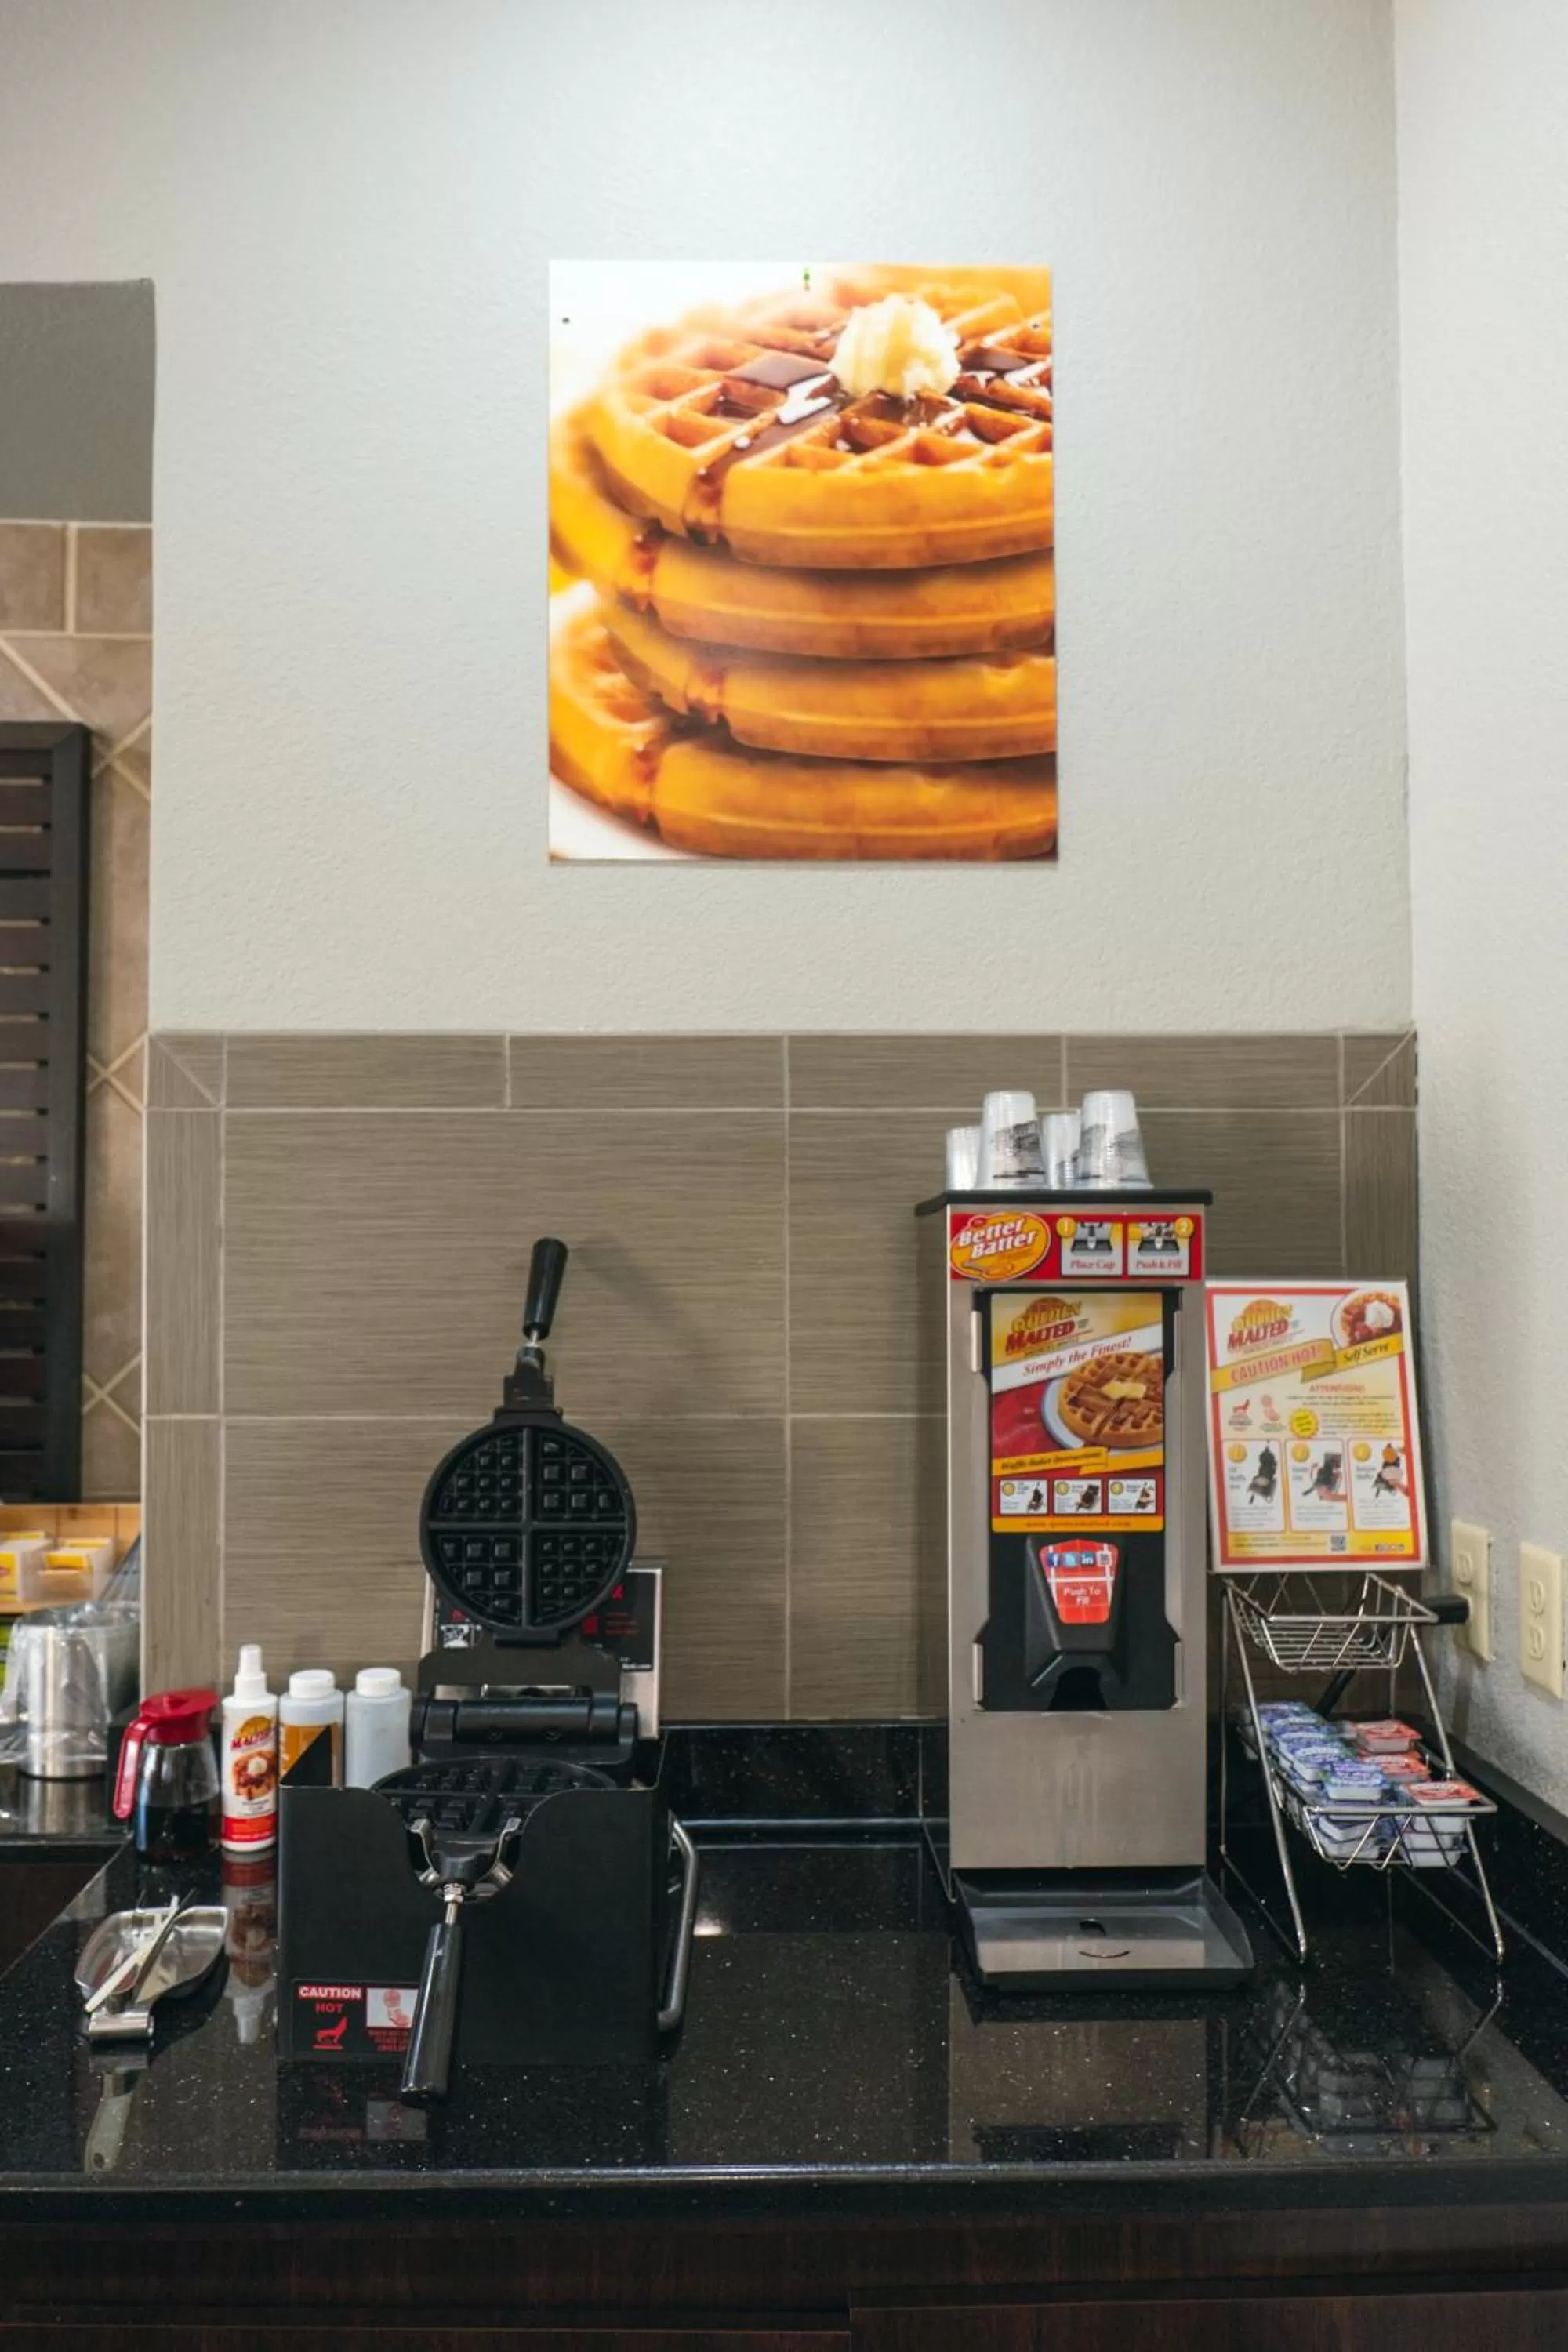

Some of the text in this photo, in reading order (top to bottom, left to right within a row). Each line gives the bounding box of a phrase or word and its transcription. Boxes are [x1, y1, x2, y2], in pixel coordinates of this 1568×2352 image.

[959, 1218, 1025, 1247] Better
[971, 1231, 1038, 1259] Batter
[1070, 1259, 1116, 1272] Place Cup
[1006, 1319, 1076, 1356] MALTED
[1228, 1319, 1289, 1353] MALTED
[1022, 1353, 1065, 1377] Simply
[1069, 1348, 1089, 1364] the
[1091, 1335, 1132, 1358] Finest!
[1344, 1341, 1391, 1363] Self Serve
[1232, 1355, 1288, 1382] CAUTION
[299, 1986, 361, 1999] CAUTION
[315, 2002, 343, 2013] HOT
